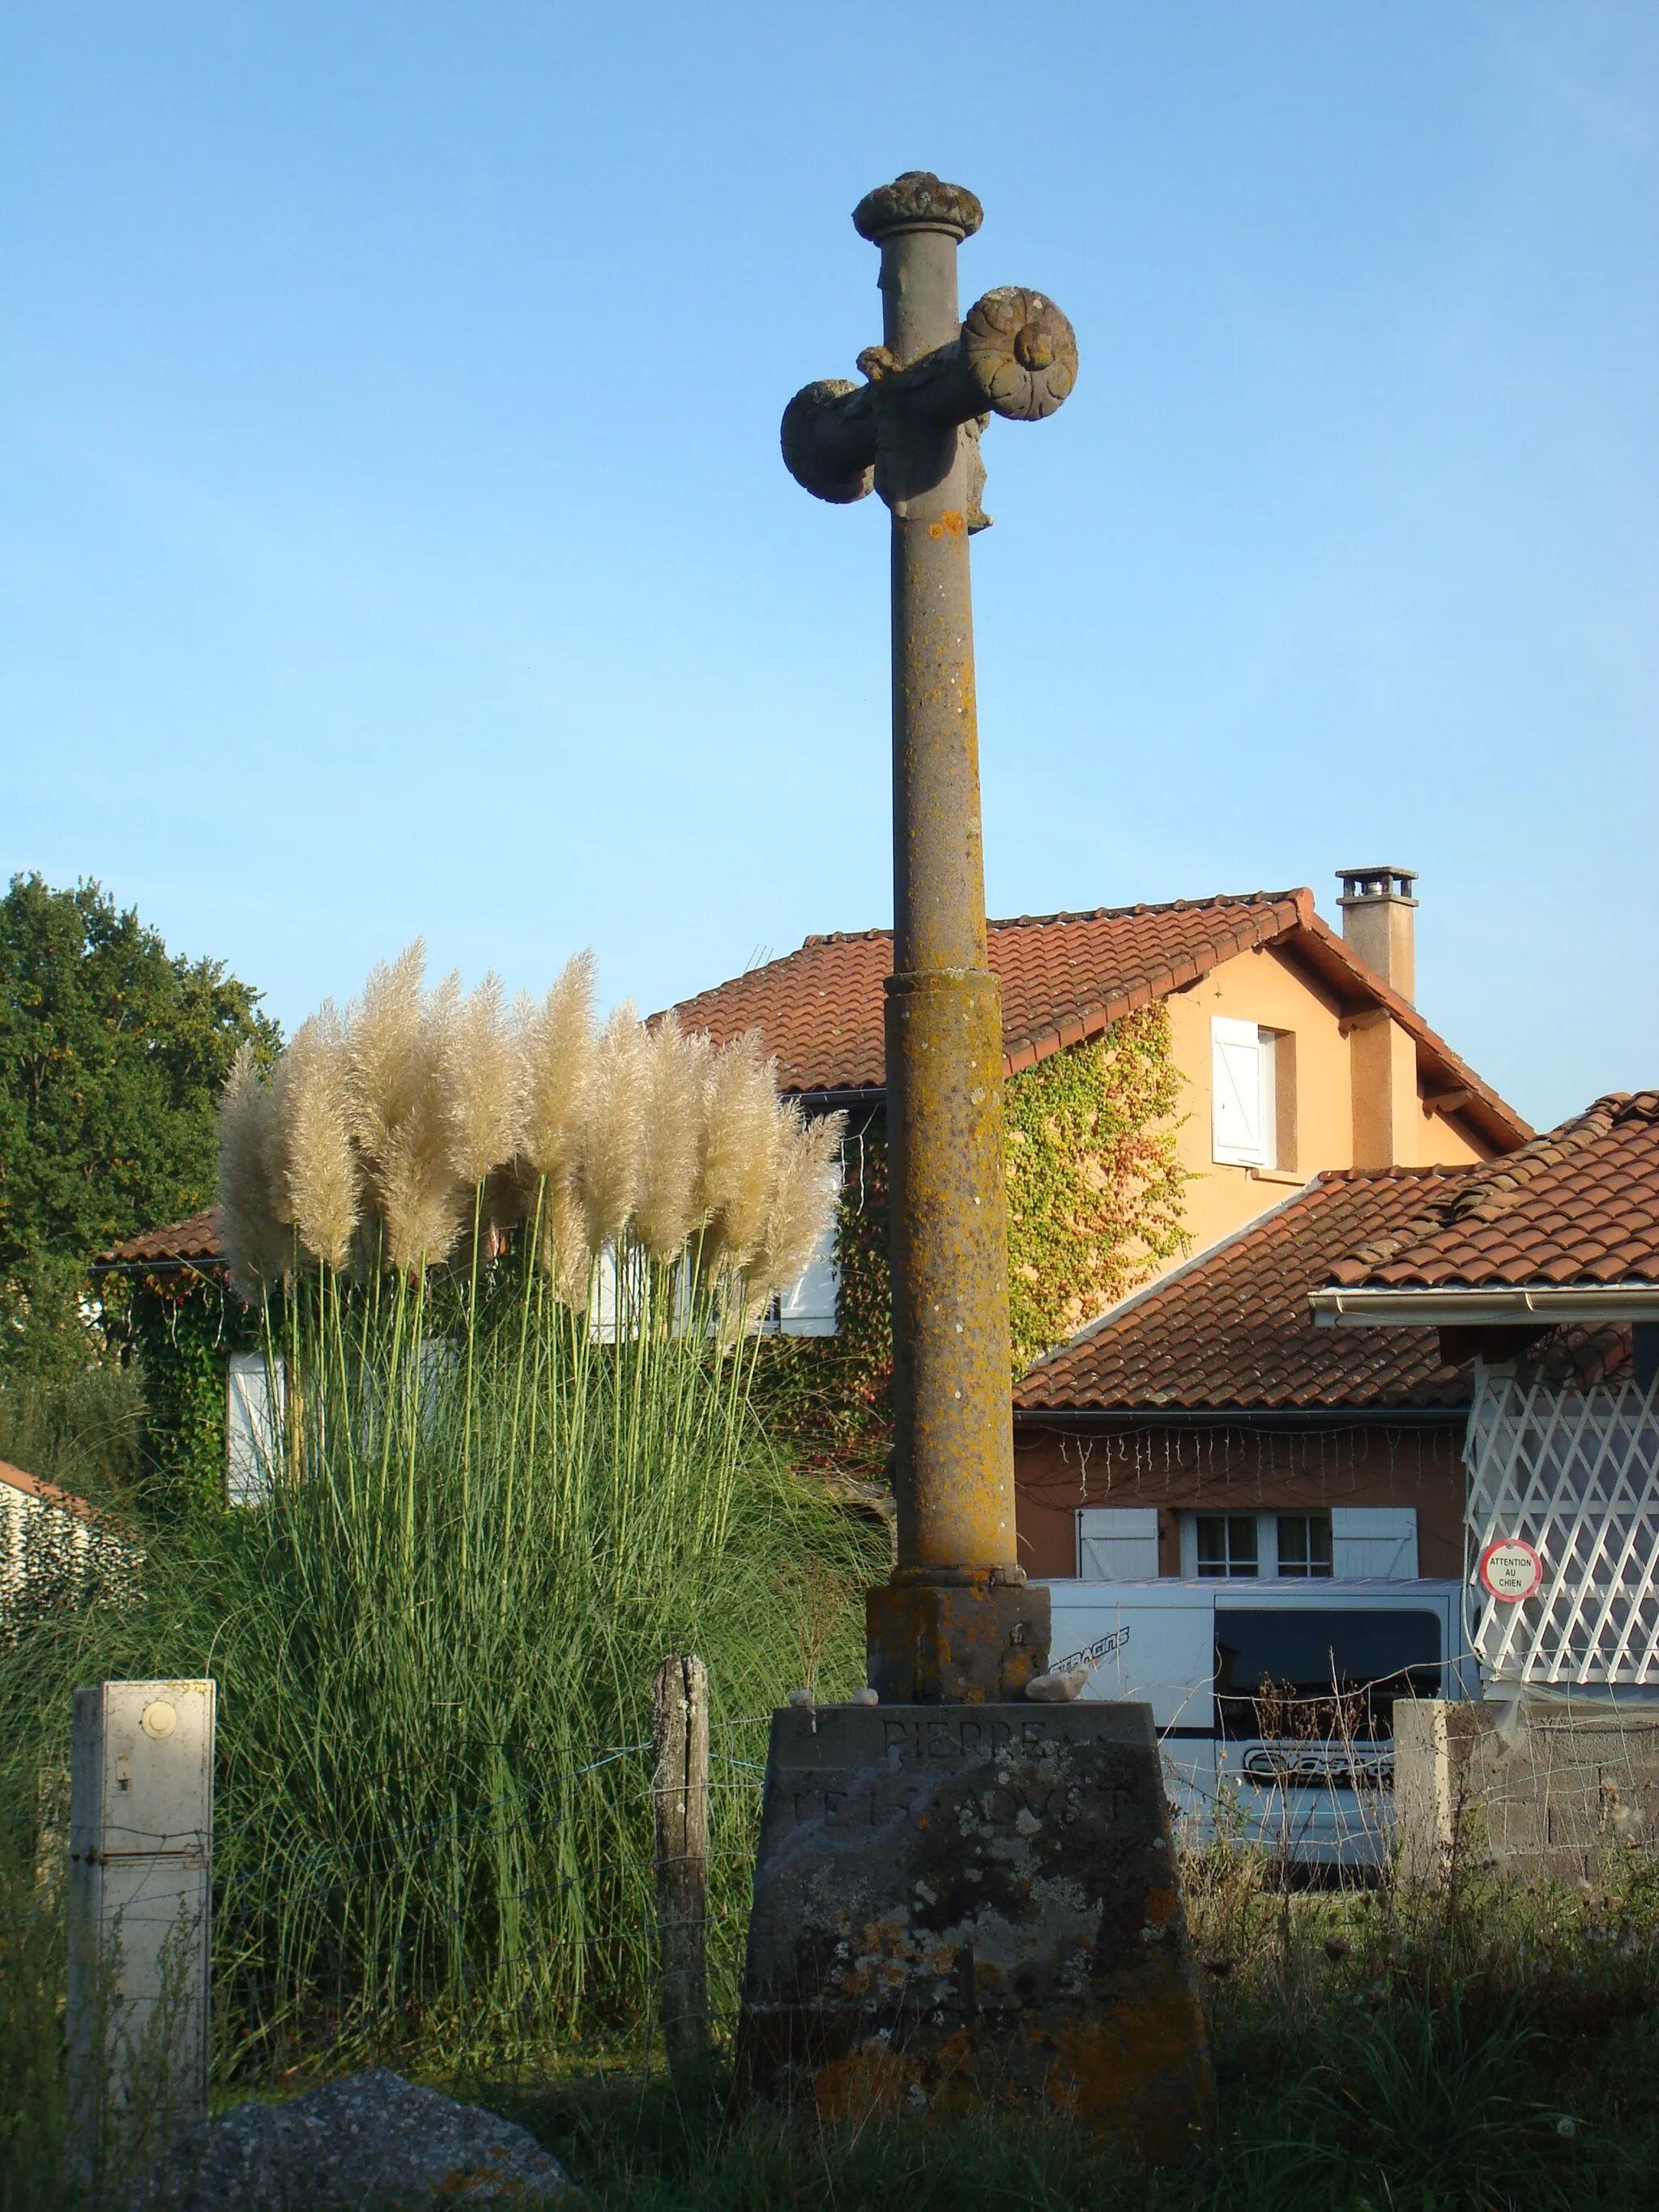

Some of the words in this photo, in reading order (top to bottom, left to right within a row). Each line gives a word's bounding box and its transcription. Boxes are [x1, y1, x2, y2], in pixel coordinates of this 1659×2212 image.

[1490, 1558, 1532, 1566] ATTENTION
[1505, 1568, 1516, 1577] AU
[1499, 1579, 1522, 1588] CHIEN
[881, 1719, 1047, 1758] PIERRE
